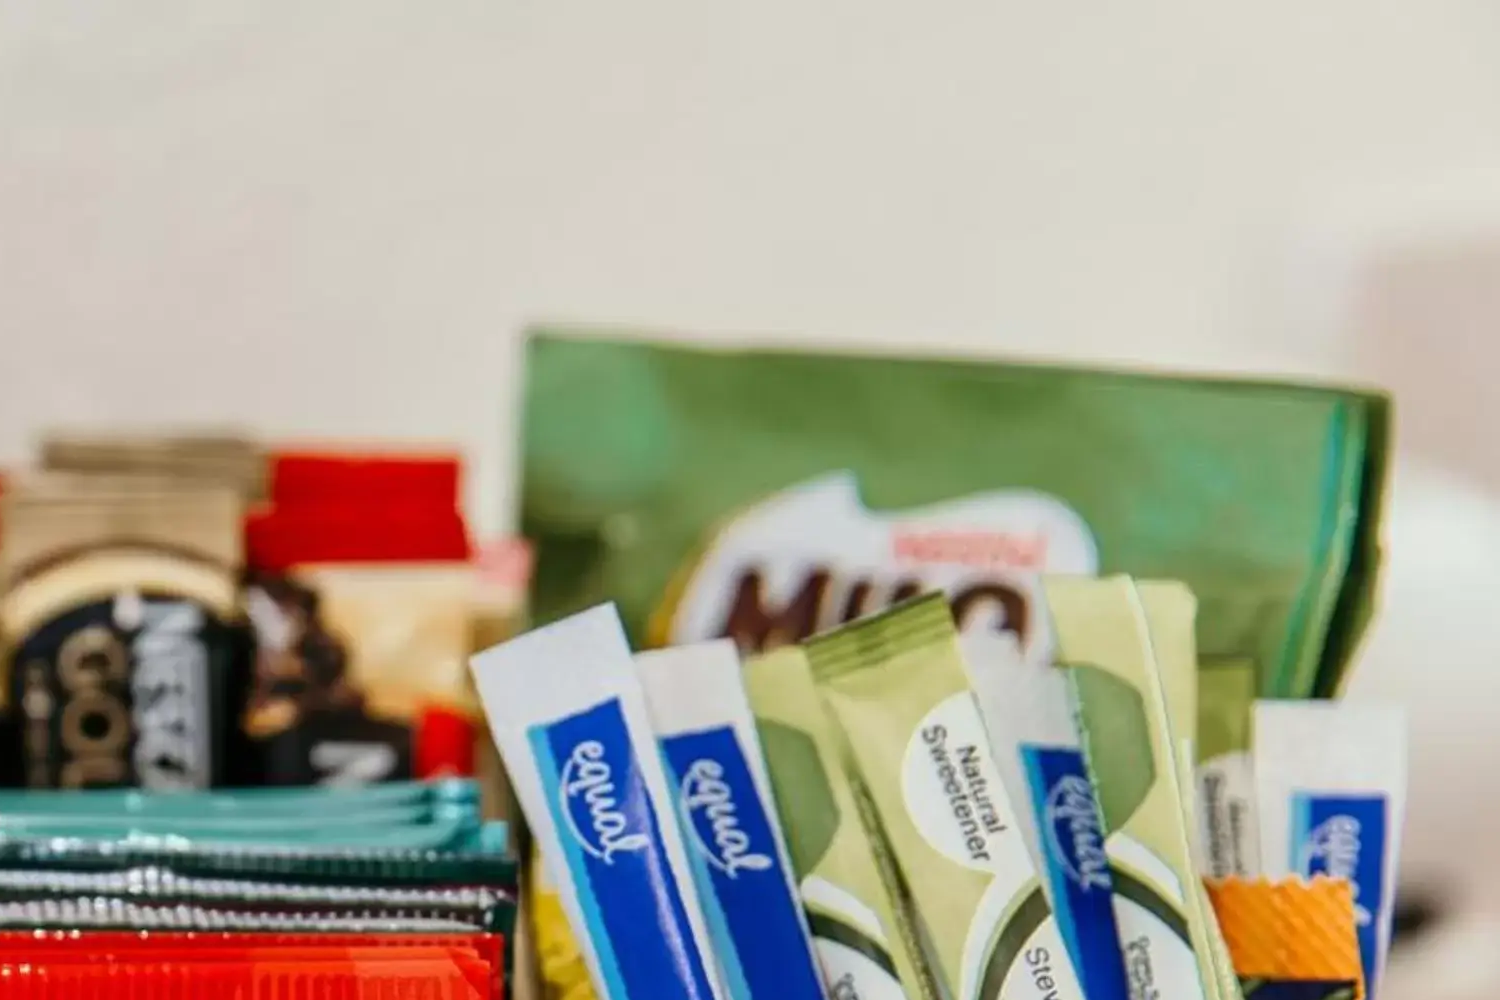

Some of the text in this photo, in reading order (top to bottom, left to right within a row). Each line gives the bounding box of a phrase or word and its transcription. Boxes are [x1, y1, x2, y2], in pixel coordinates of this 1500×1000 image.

[562, 740, 650, 865] equal
[683, 759, 772, 878] equal
[921, 724, 991, 862] Sweetener
[956, 745, 1008, 835] Natural
